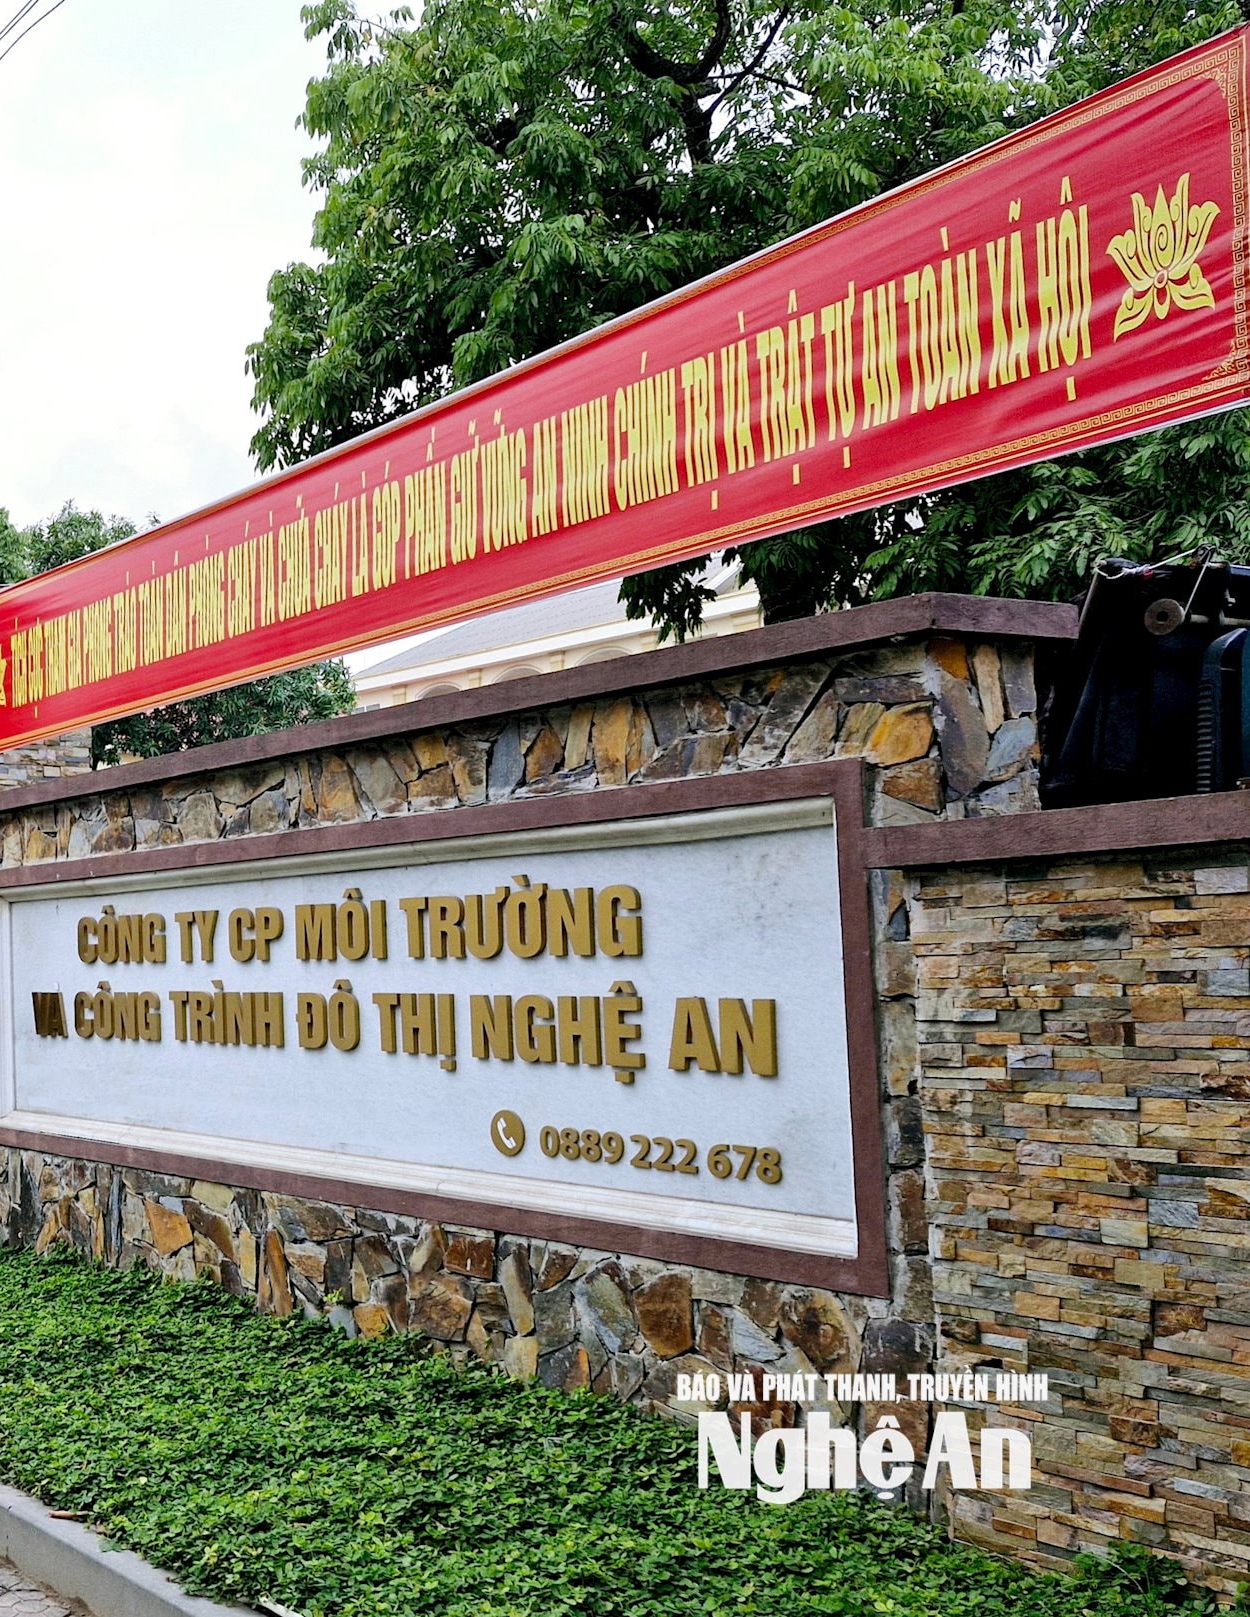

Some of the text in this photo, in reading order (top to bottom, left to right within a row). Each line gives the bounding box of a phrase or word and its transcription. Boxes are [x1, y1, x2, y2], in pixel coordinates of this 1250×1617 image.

[11, 617, 27, 708] TÍCH
[44, 615, 66, 697] THAM
[68, 609, 82, 690] GIA
[83, 595, 112, 685] PHONG
[114, 571, 137, 675] TRÀO
[138, 560, 164, 667] TOÀN
[166, 550, 186, 659] DÂN
[189, 535, 225, 651] PHÒNG
[228, 520, 257, 639] CHÁY
[259, 511, 276, 628] VÀ
[278, 494, 311, 622] CHỮA
[314, 482, 348, 610] CHÁY
[352, 471, 369, 598] LÀ
[372, 460, 400, 591] GÓP
[405, 427, 446, 580] PHẦN
[451, 419, 479, 565] GIỮ
[481, 408, 528, 554] VỮNG
[532, 416, 558, 538] AN
[561, 394, 611, 528] NINH
[614, 351, 680, 511] CHÍNH
[681, 352, 719, 510] TRỊ
[720, 311, 755, 475] VÀ
[756, 289, 816, 486] TRẬT
[820, 281, 857, 469] TỰ
[862, 280, 900, 430] AN
[904, 226, 982, 415] TOÀN
[986, 197, 1031, 389] XÃ
[1036, 175, 1092, 402] HỘI
[77, 874, 643, 964] CÔNG TY CP MÔI TRƯỜNG
[74, 980, 162, 1042] CÔNG
[169, 979, 284, 1048] TRÌNH
[296, 979, 361, 1051] ĐÔ
[372, 992, 457, 1072] THỊ
[469, 980, 646, 1084] NGHỆ
[668, 996, 778, 1077] AN
[539, 1125, 782, 1184] 0889 222 678
